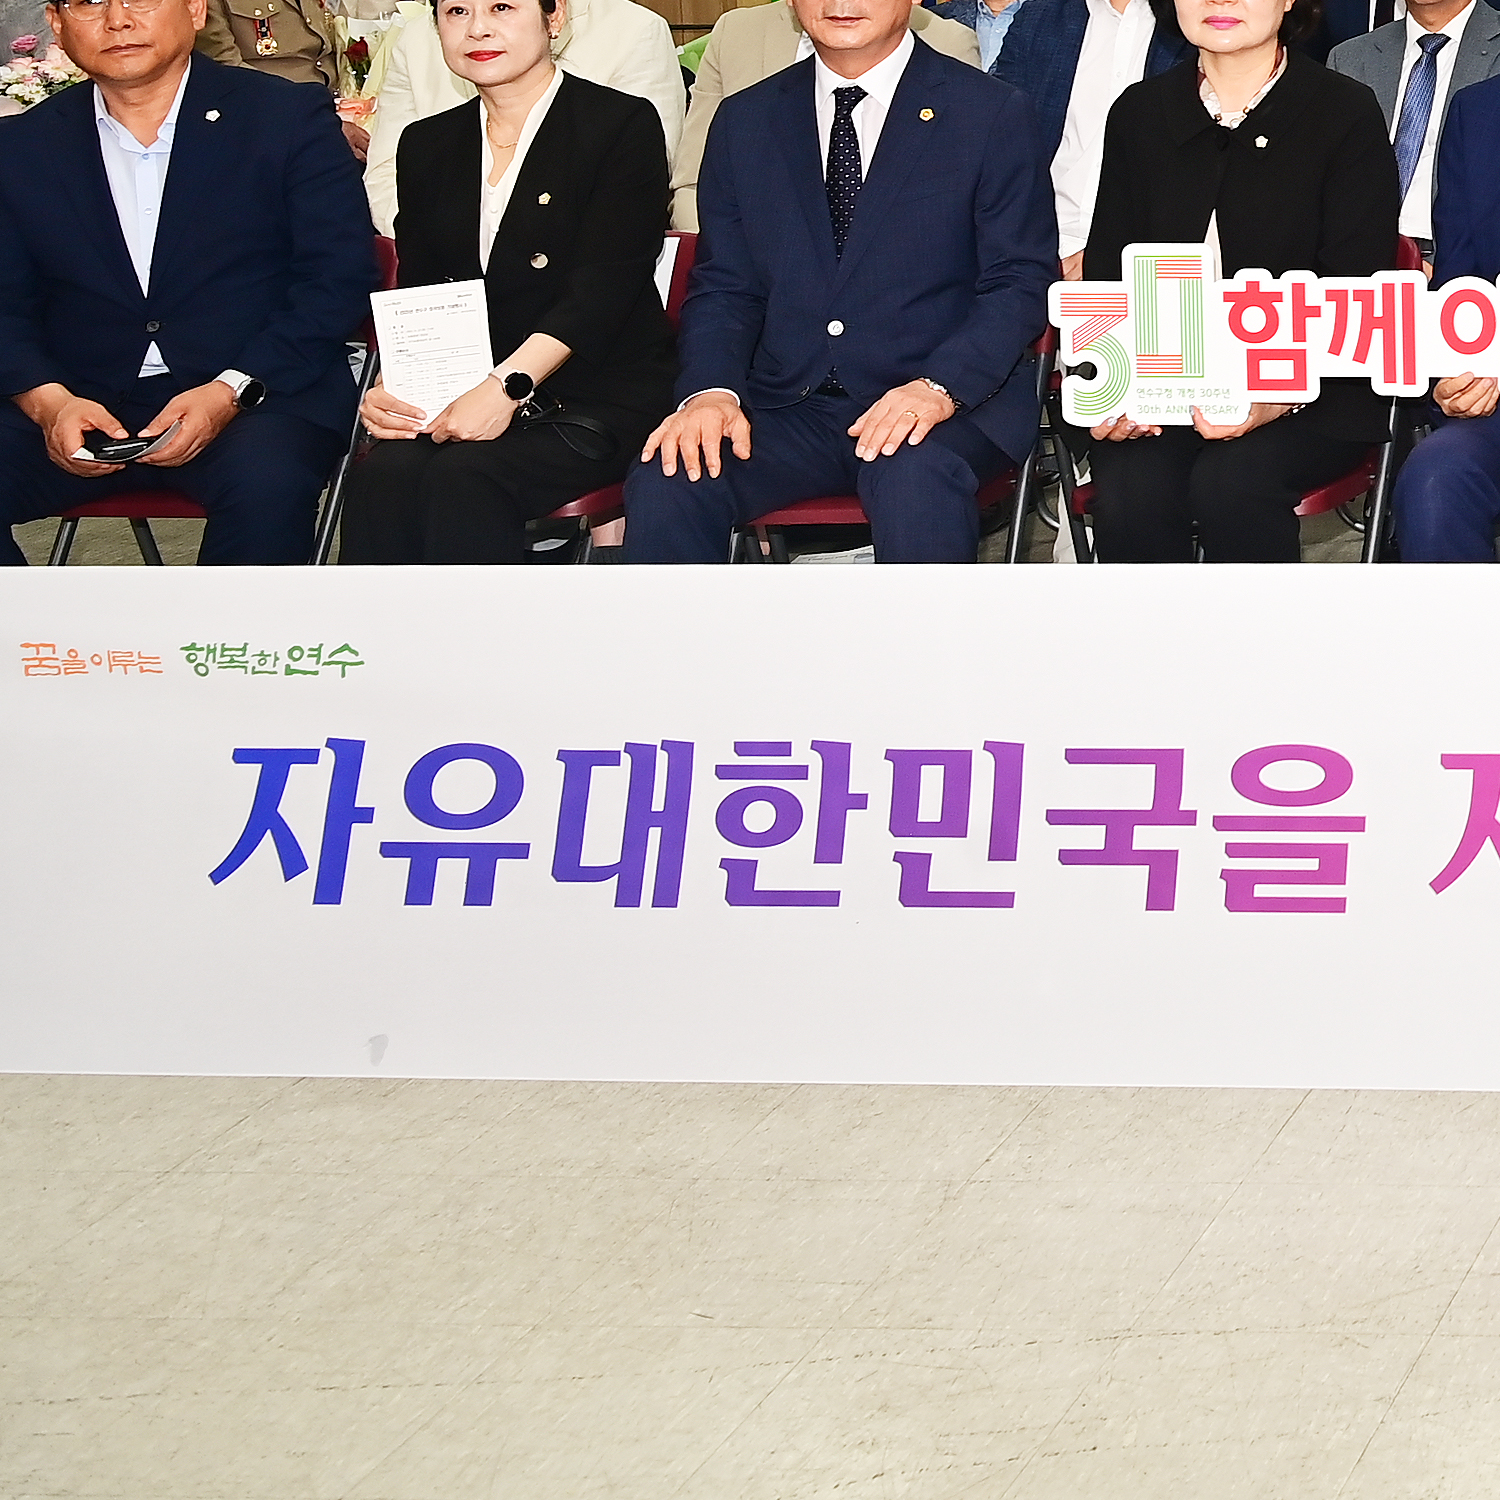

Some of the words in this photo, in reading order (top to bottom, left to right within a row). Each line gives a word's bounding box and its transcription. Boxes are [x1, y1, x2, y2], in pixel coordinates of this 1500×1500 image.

[1222, 280, 1417, 391] 함께
[1137, 404, 1161, 414] 30th
[1165, 404, 1239, 414] ANNERSARY
[1199, 387, 1231, 399] 30주년
[208, 736, 1367, 925] 자유대한민국을
